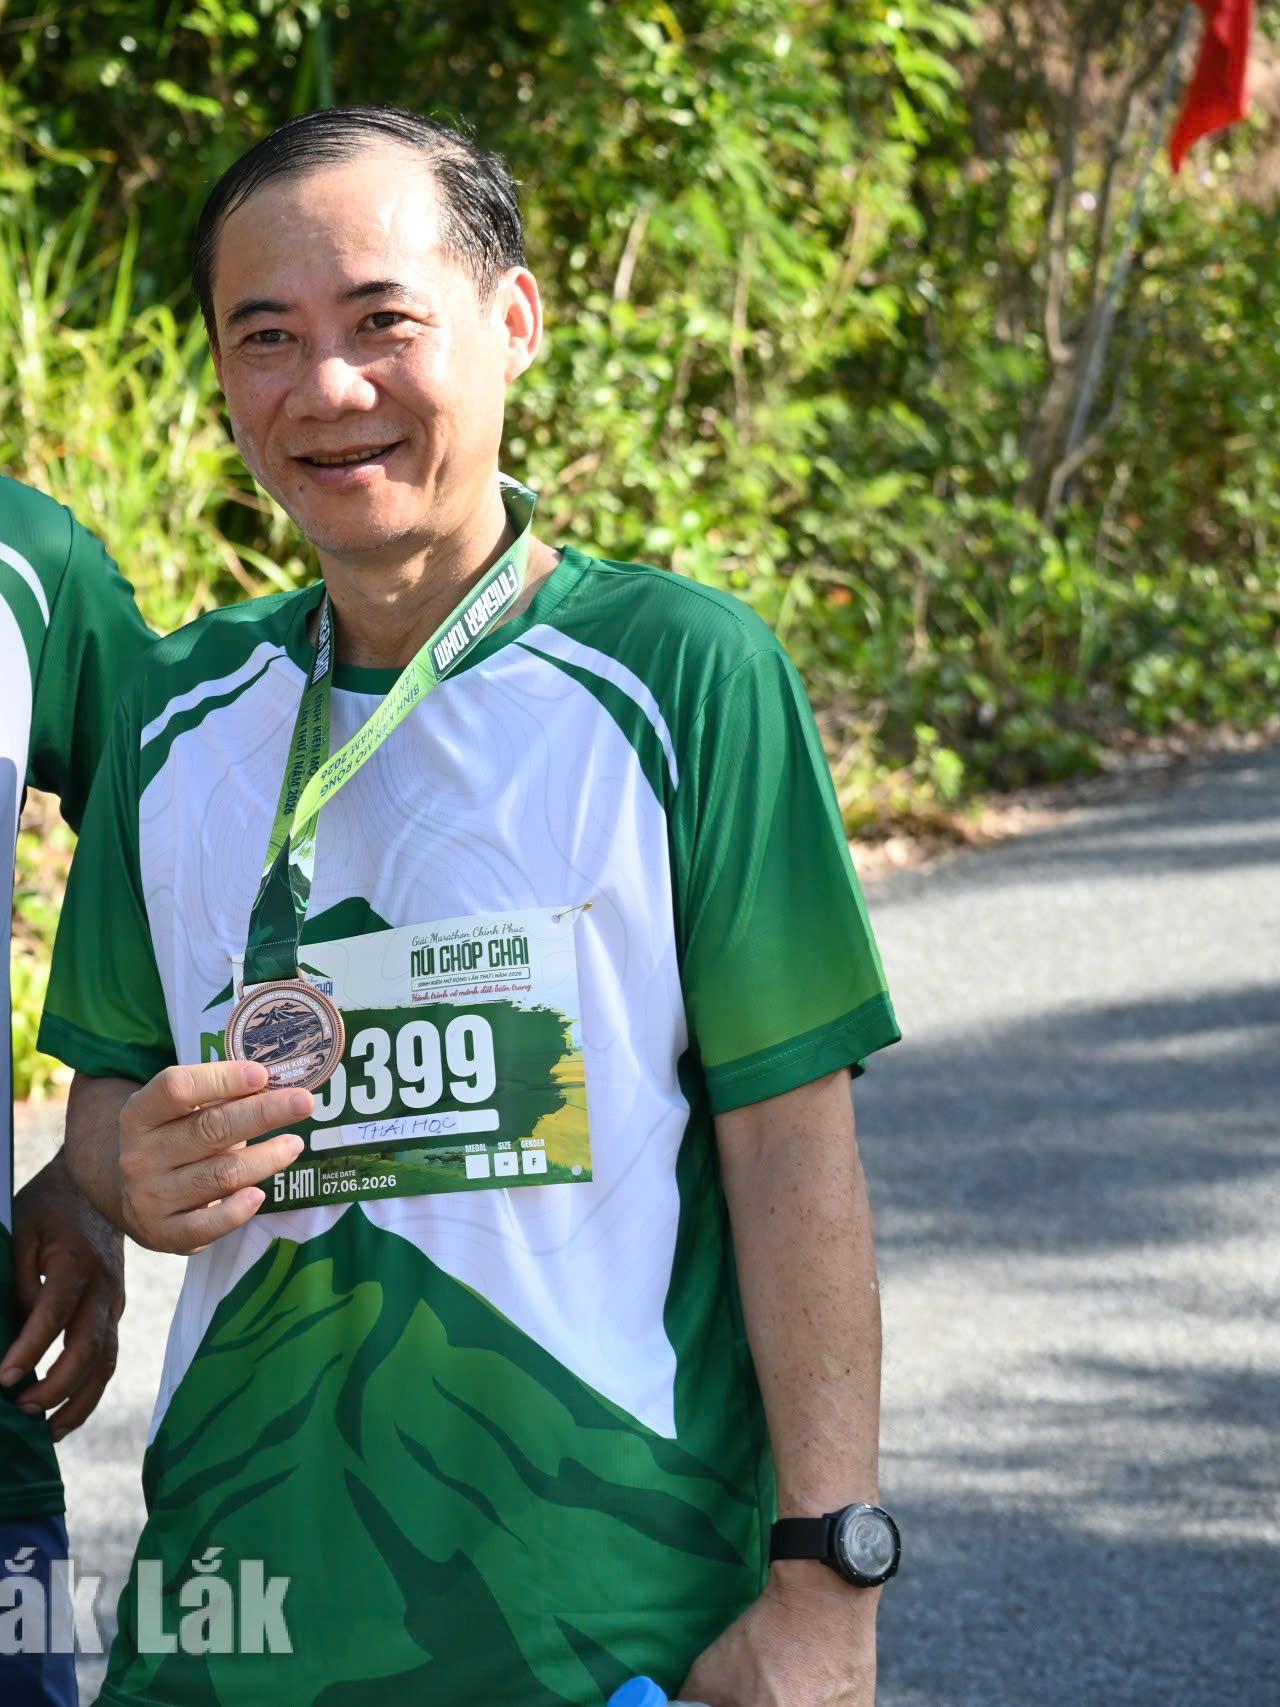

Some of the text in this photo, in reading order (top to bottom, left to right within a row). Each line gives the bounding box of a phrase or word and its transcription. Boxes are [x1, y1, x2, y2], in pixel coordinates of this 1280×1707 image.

[433, 564, 520, 671] FINISHER 10KM
[283, 788, 299, 816] 2026
[430, 929, 470, 944] Marathon
[410, 935, 530, 978] NÚI CHÓP CHÀI
[358, 1119, 406, 1140] THÁI
[465, 1138, 546, 1153] MEDAL SIZE GENDER
[531, 1157, 538, 1167] F
[273, 1167, 315, 1202] 5 KM
[322, 1169, 357, 1181] RACE DATE
[322, 1174, 397, 1195] 07.06.2026
